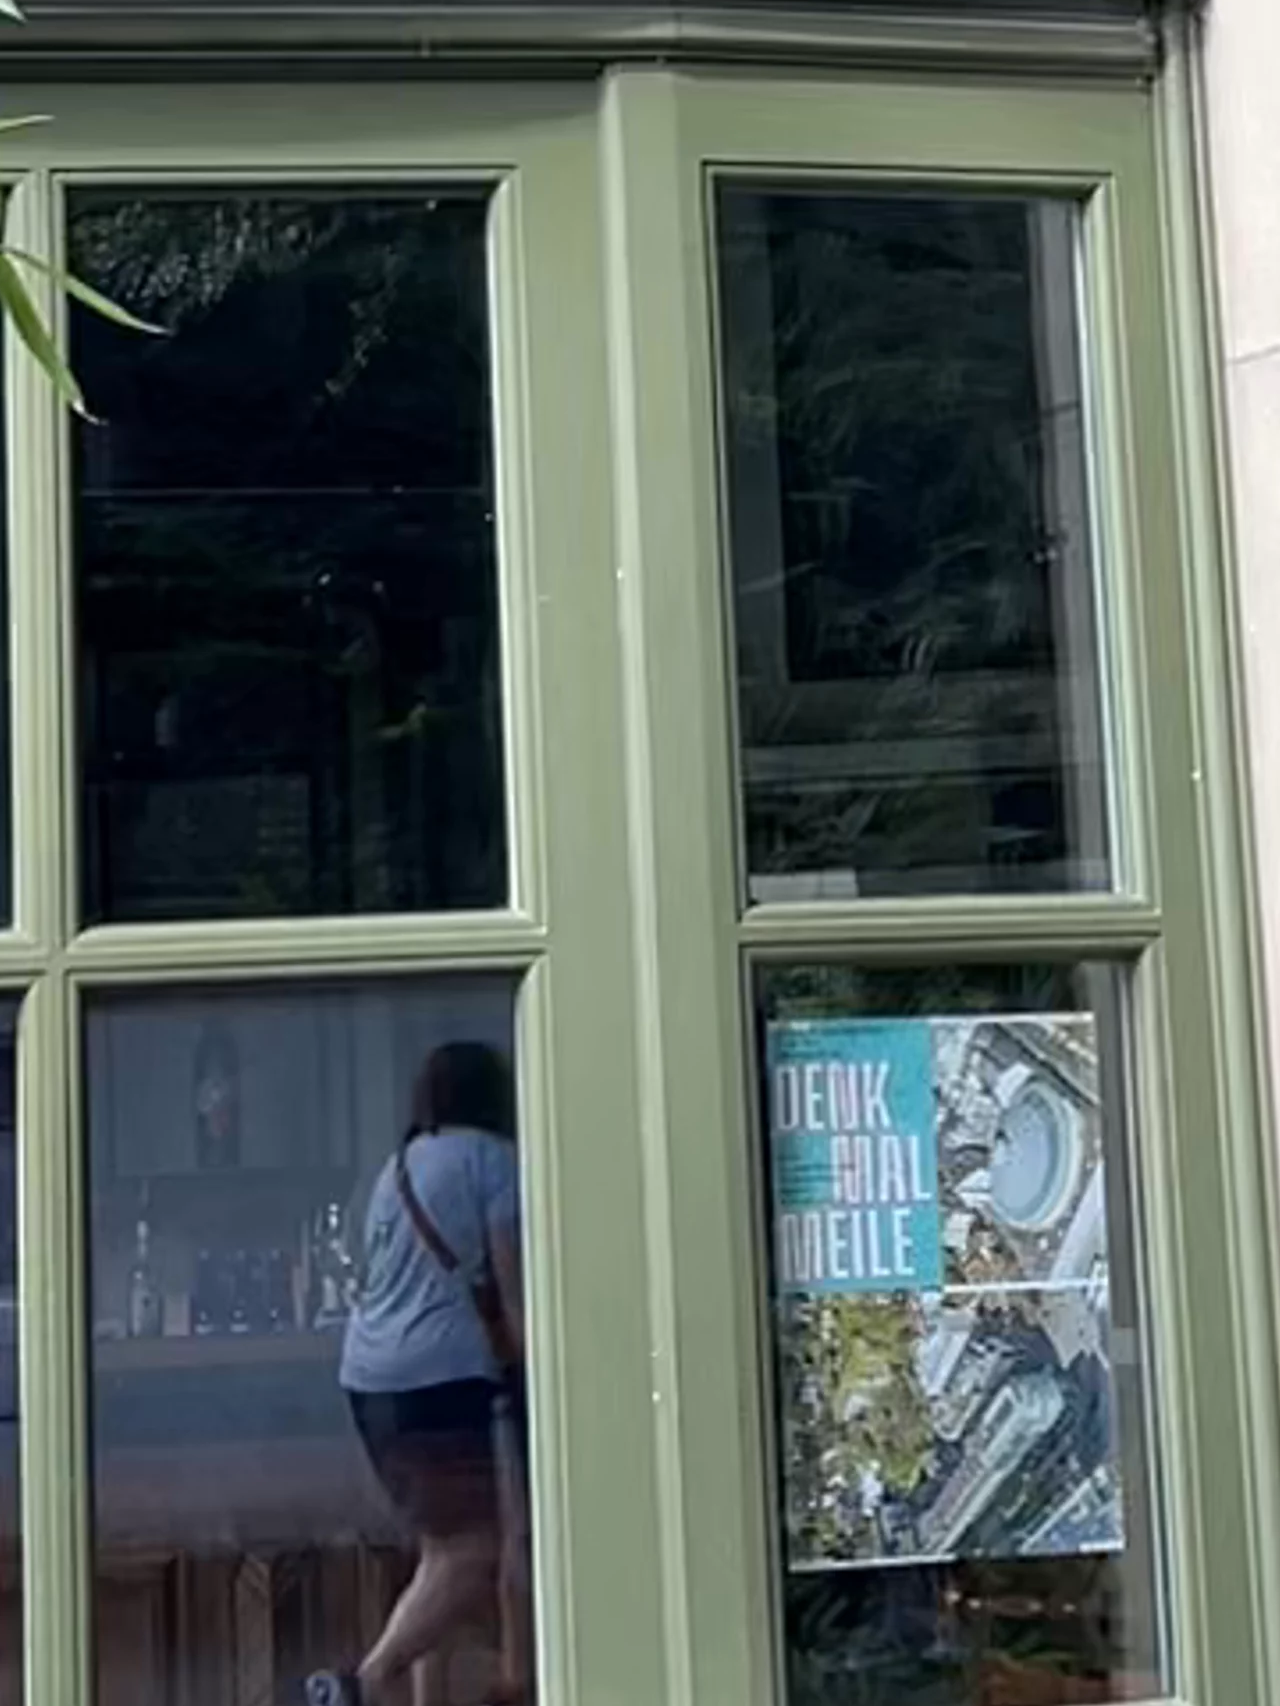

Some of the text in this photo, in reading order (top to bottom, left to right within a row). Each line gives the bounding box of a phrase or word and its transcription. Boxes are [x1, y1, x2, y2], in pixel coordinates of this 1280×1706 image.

[777, 1060, 891, 1130] DENK
[830, 1135, 932, 1203] MAL
[780, 1208, 916, 1282] MEILE
